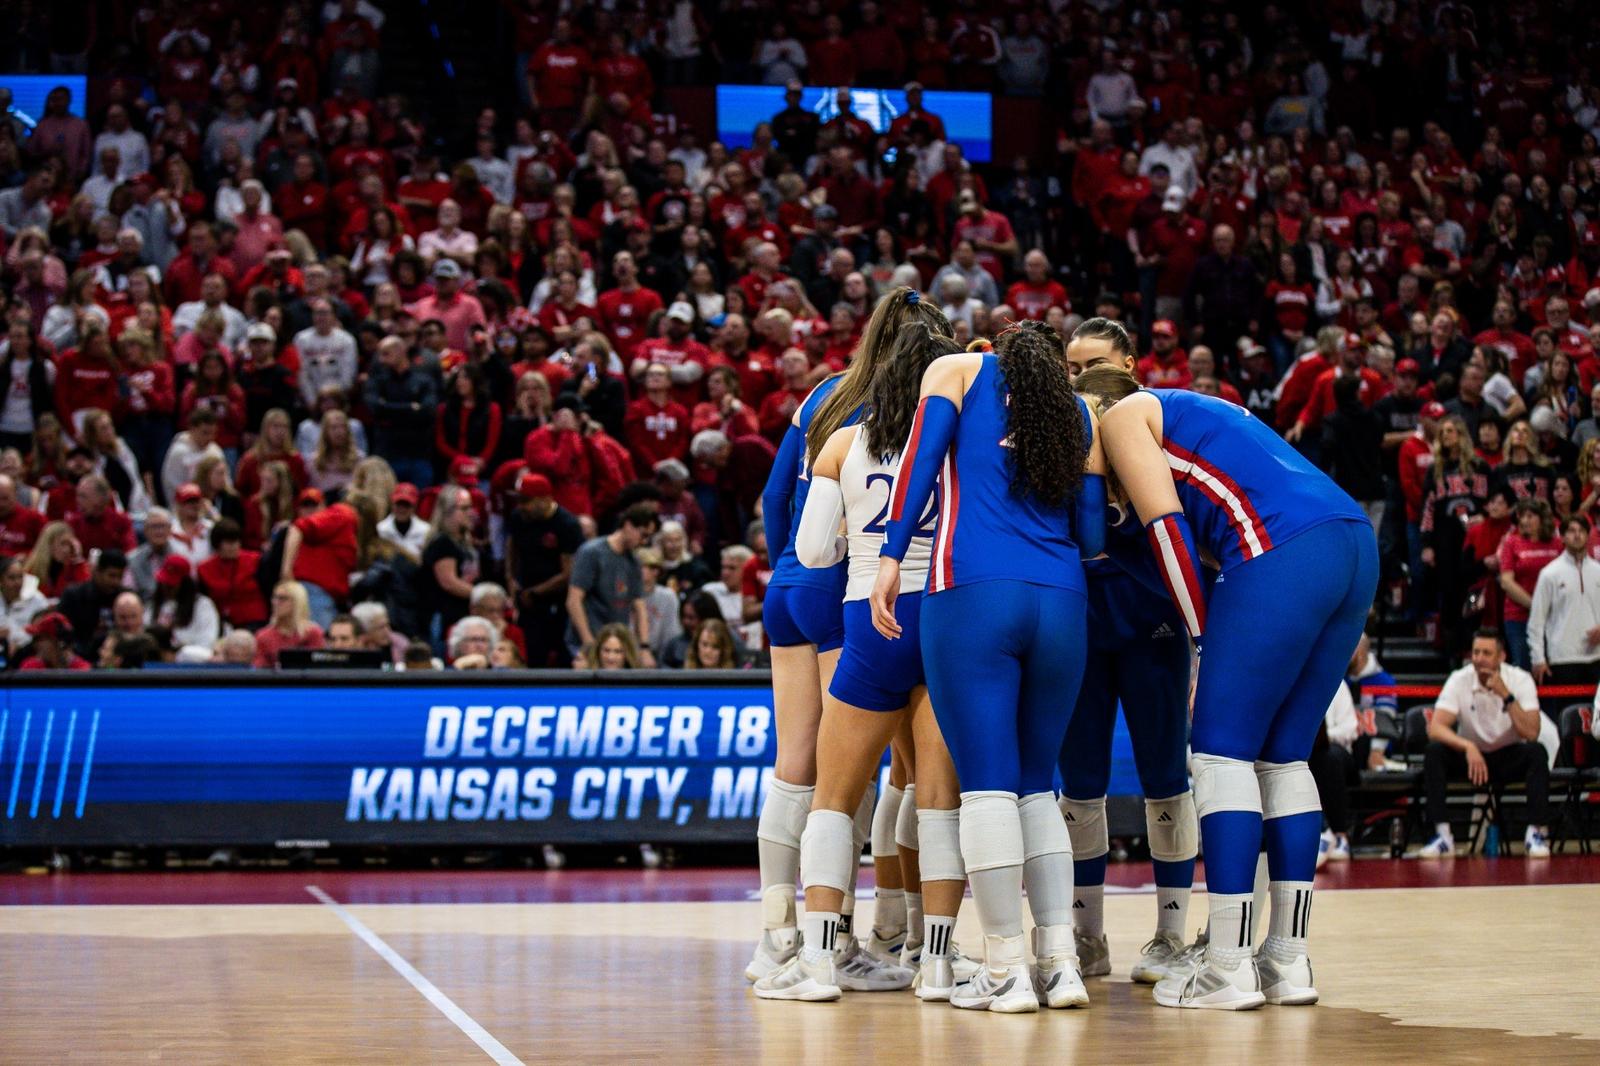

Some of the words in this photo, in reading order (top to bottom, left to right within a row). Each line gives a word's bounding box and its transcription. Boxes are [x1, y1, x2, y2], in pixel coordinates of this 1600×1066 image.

[879, 451, 901, 466] W
[423, 705, 704, 759] DECEMBER
[717, 705, 772, 759] 18
[346, 767, 558, 821] KANSAS
[568, 767, 691, 826] CITY,
